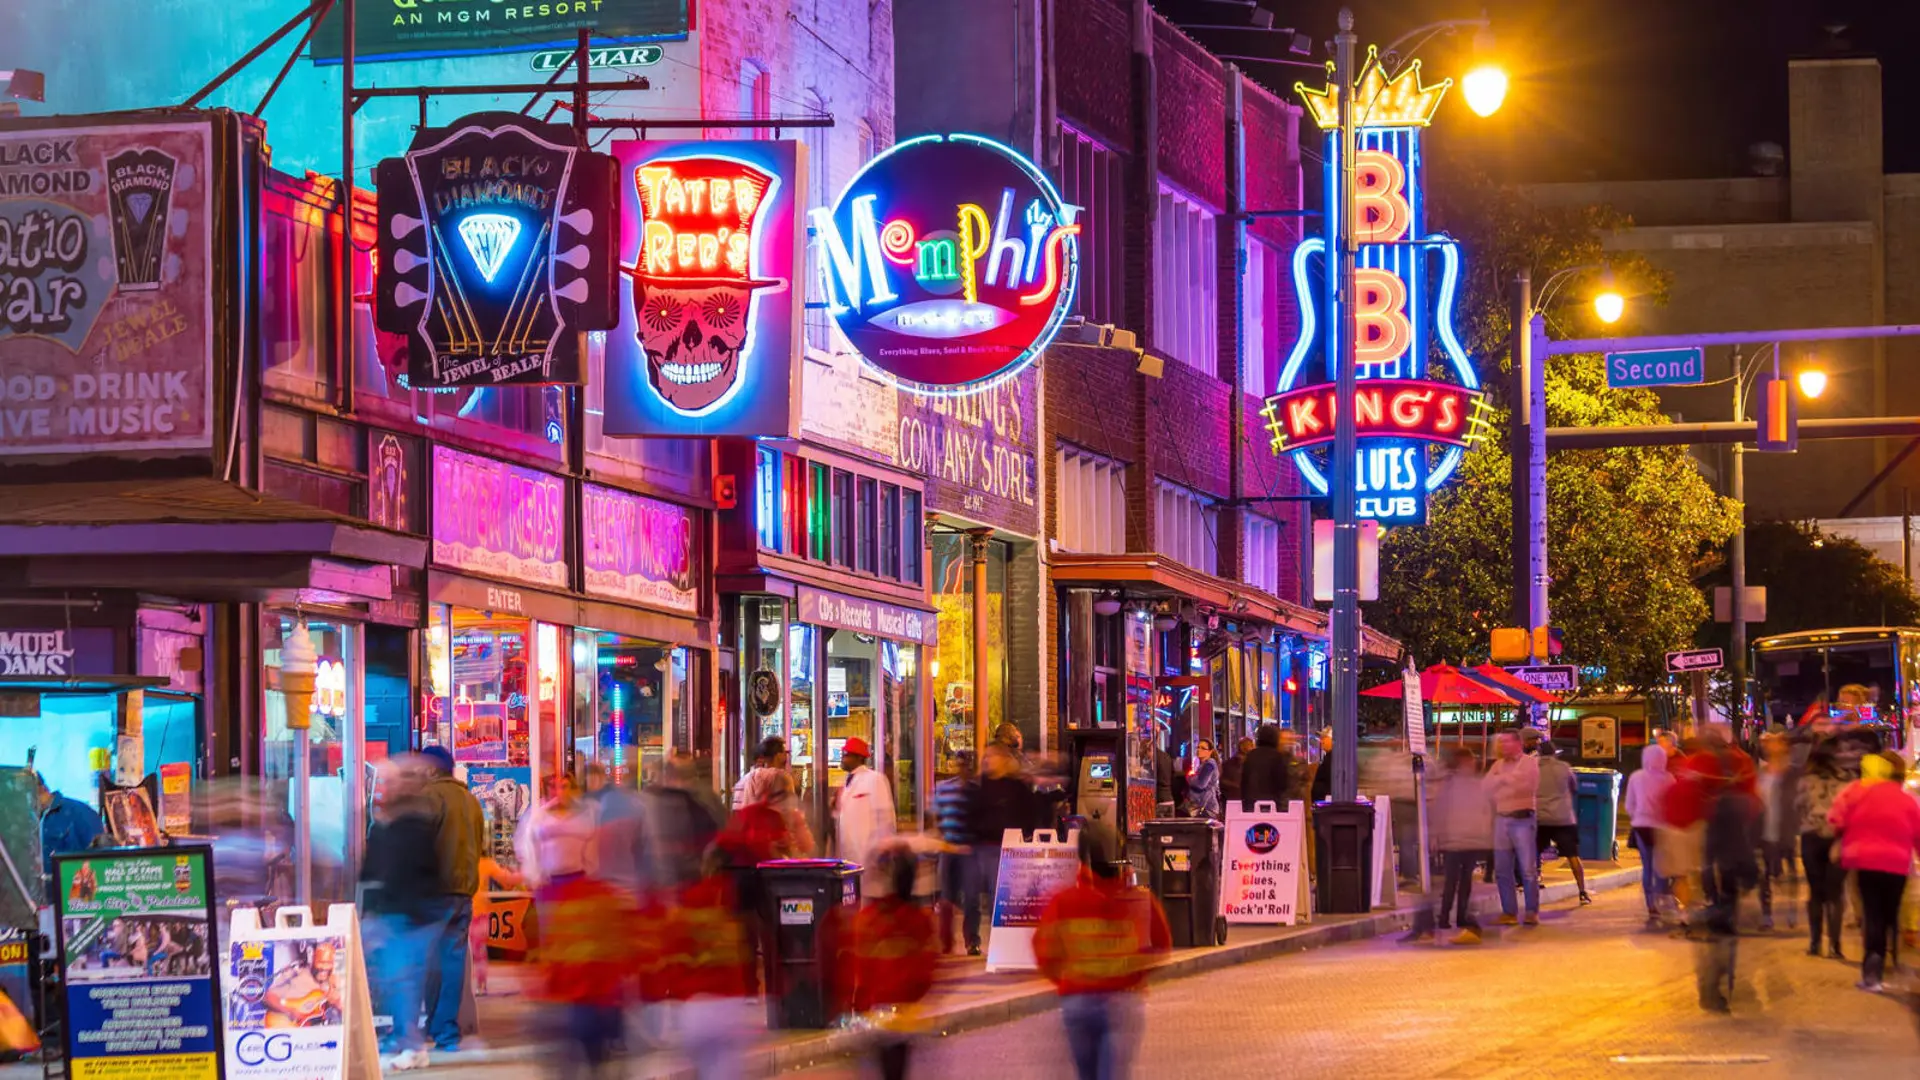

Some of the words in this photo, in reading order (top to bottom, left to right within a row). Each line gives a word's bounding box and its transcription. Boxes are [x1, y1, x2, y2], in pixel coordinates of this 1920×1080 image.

[393, 13, 423, 25] AN
[438, 10, 490, 22] MGM
[506, 1, 602, 20] RESORT
[116, 164, 167, 178] BLACK
[112, 176, 169, 194] DIAMOND
[638, 166, 757, 220] TATER
[644, 220, 750, 273] RED'S
[807, 186, 1084, 315] Memphis
[439, 354, 460, 369] The
[880, 345, 919, 358] Everything
[943, 345, 960, 356] Soul
[441, 357, 492, 385] JEWEL
[492, 354, 503, 367] of
[490, 354, 543, 383] BEALE
[1613, 356, 1695, 381] Second
[74, 370, 190, 400] DRINK
[69, 404, 175, 436] MUSIC
[1288, 388, 1460, 437] KING'S
[981, 439, 1034, 507] STORE
[1356, 447, 1417, 492] LUES
[487, 587, 523, 612] ENTER
[818, 594, 834, 623] CDs
[840, 599, 873, 631] Records
[877, 606, 906, 636] Musical
[905, 613, 923, 640] Gifts
[1684, 655, 1698, 665] ONE
[1699, 653, 1717, 664] WAY
[1524, 672, 1543, 683] ONE
[1545, 672, 1567, 683] WAY
[104, 867, 125, 877] HALL
[140, 865, 163, 876] FAME
[1231, 859, 1291, 873] Everything
[98, 885, 124, 893] PROUD
[161, 882, 172, 890] OF
[1242, 874, 1277, 887] Blues,
[1241, 889, 1266, 901] Soul
[1267, 889, 1276, 901] &
[1225, 903, 1290, 916] Rock'n'Roll
